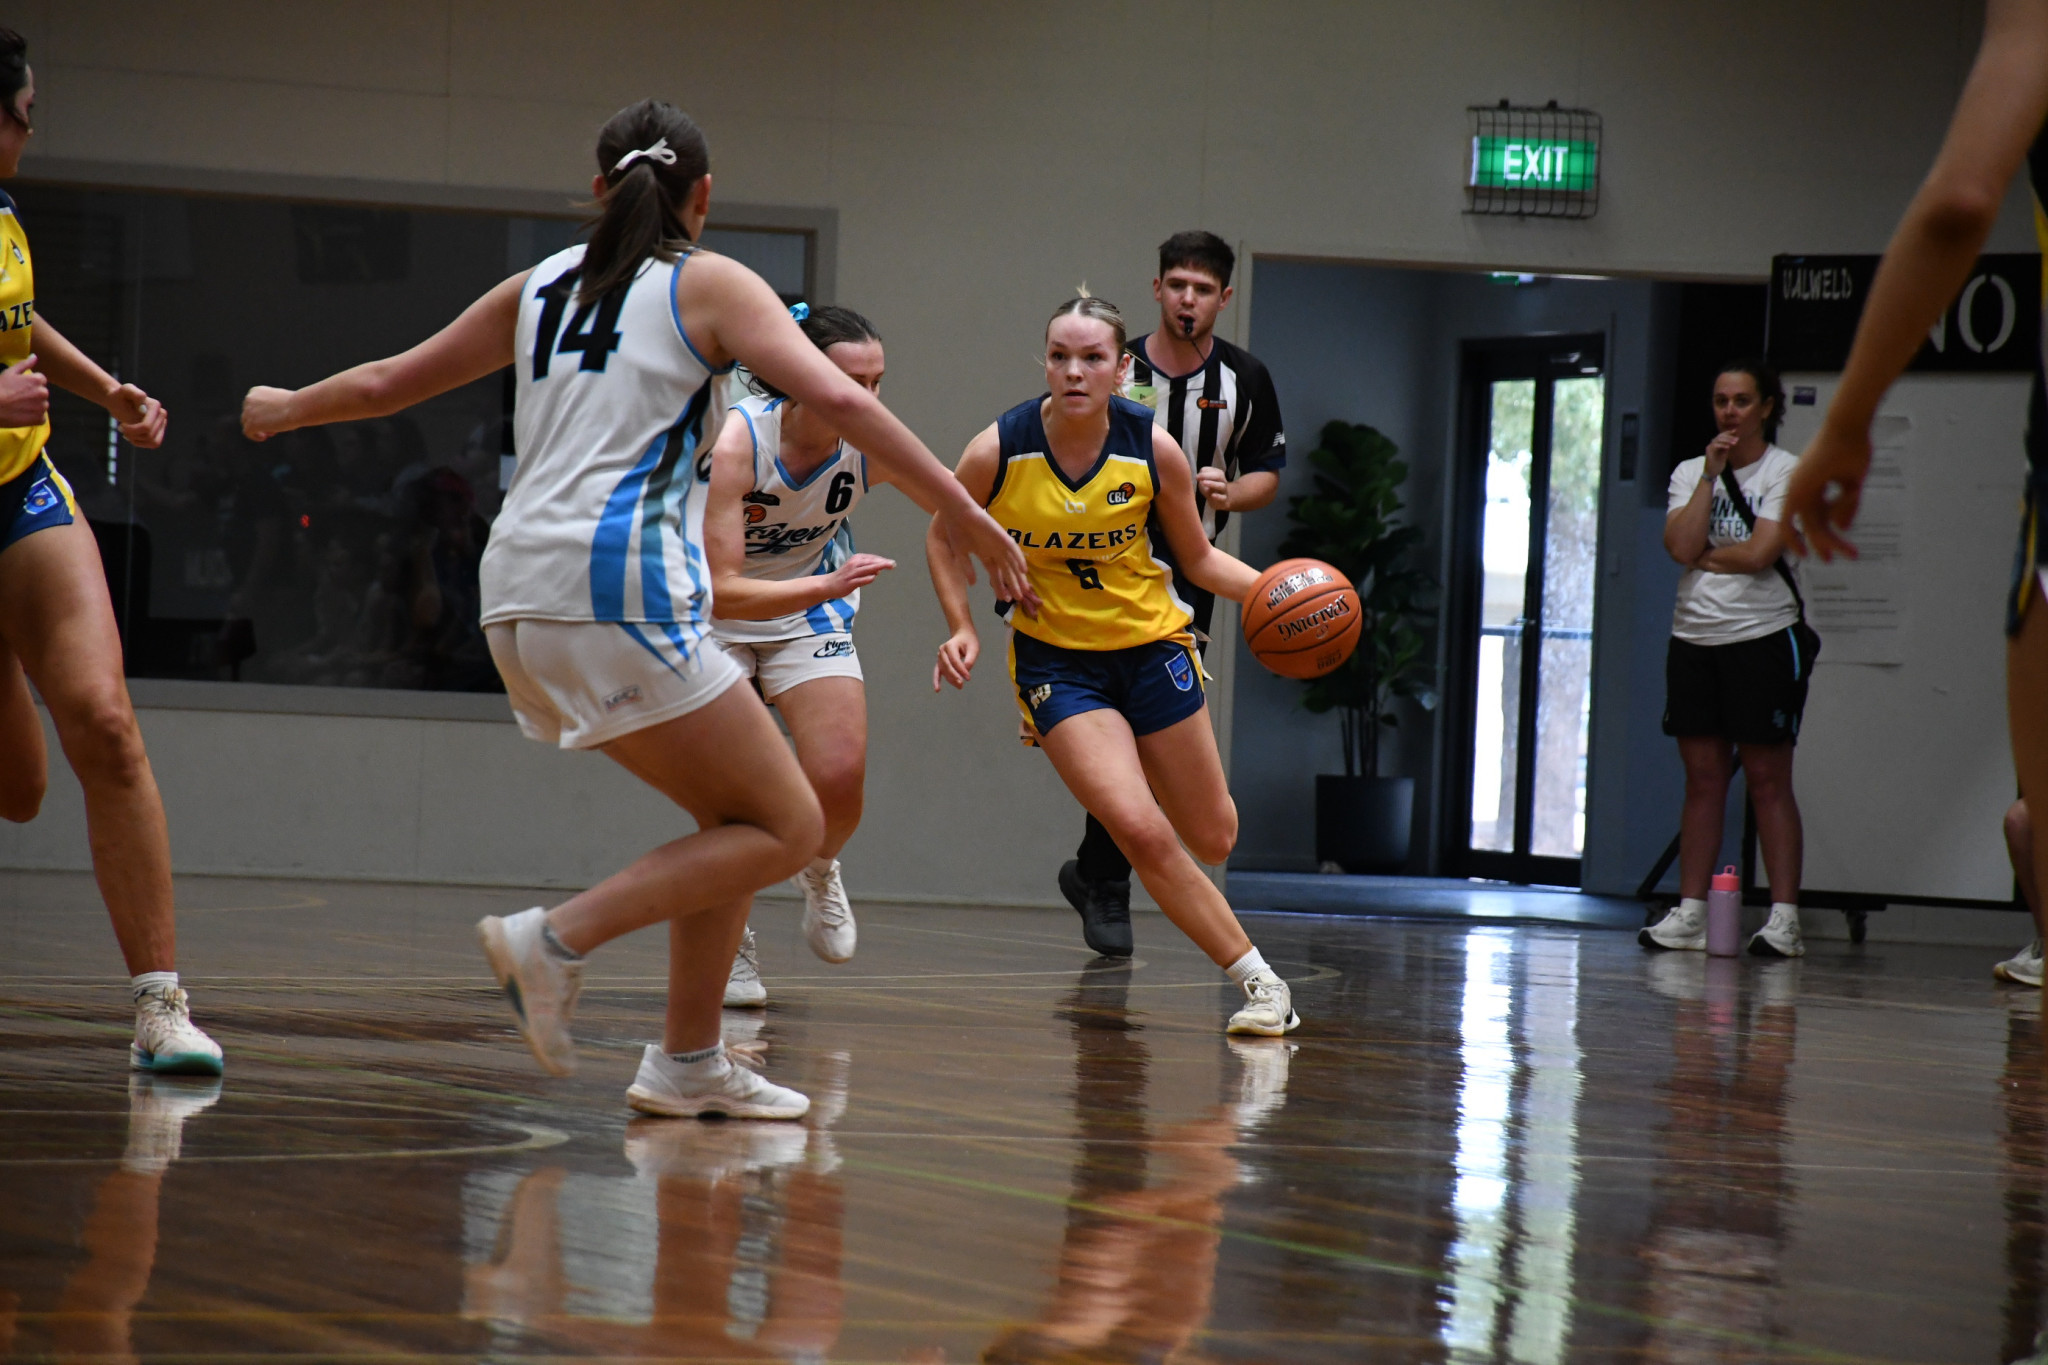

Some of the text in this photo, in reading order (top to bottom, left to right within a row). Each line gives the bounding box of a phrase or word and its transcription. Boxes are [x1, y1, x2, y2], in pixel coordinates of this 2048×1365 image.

[1503, 144, 1569, 182] EXIT
[532, 267, 635, 382] 14
[825, 470, 856, 515] 6
[1108, 491, 1128, 504] CBL
[1007, 523, 1137, 549] BLAZERS
[1278, 594, 1350, 641] SPALDING
